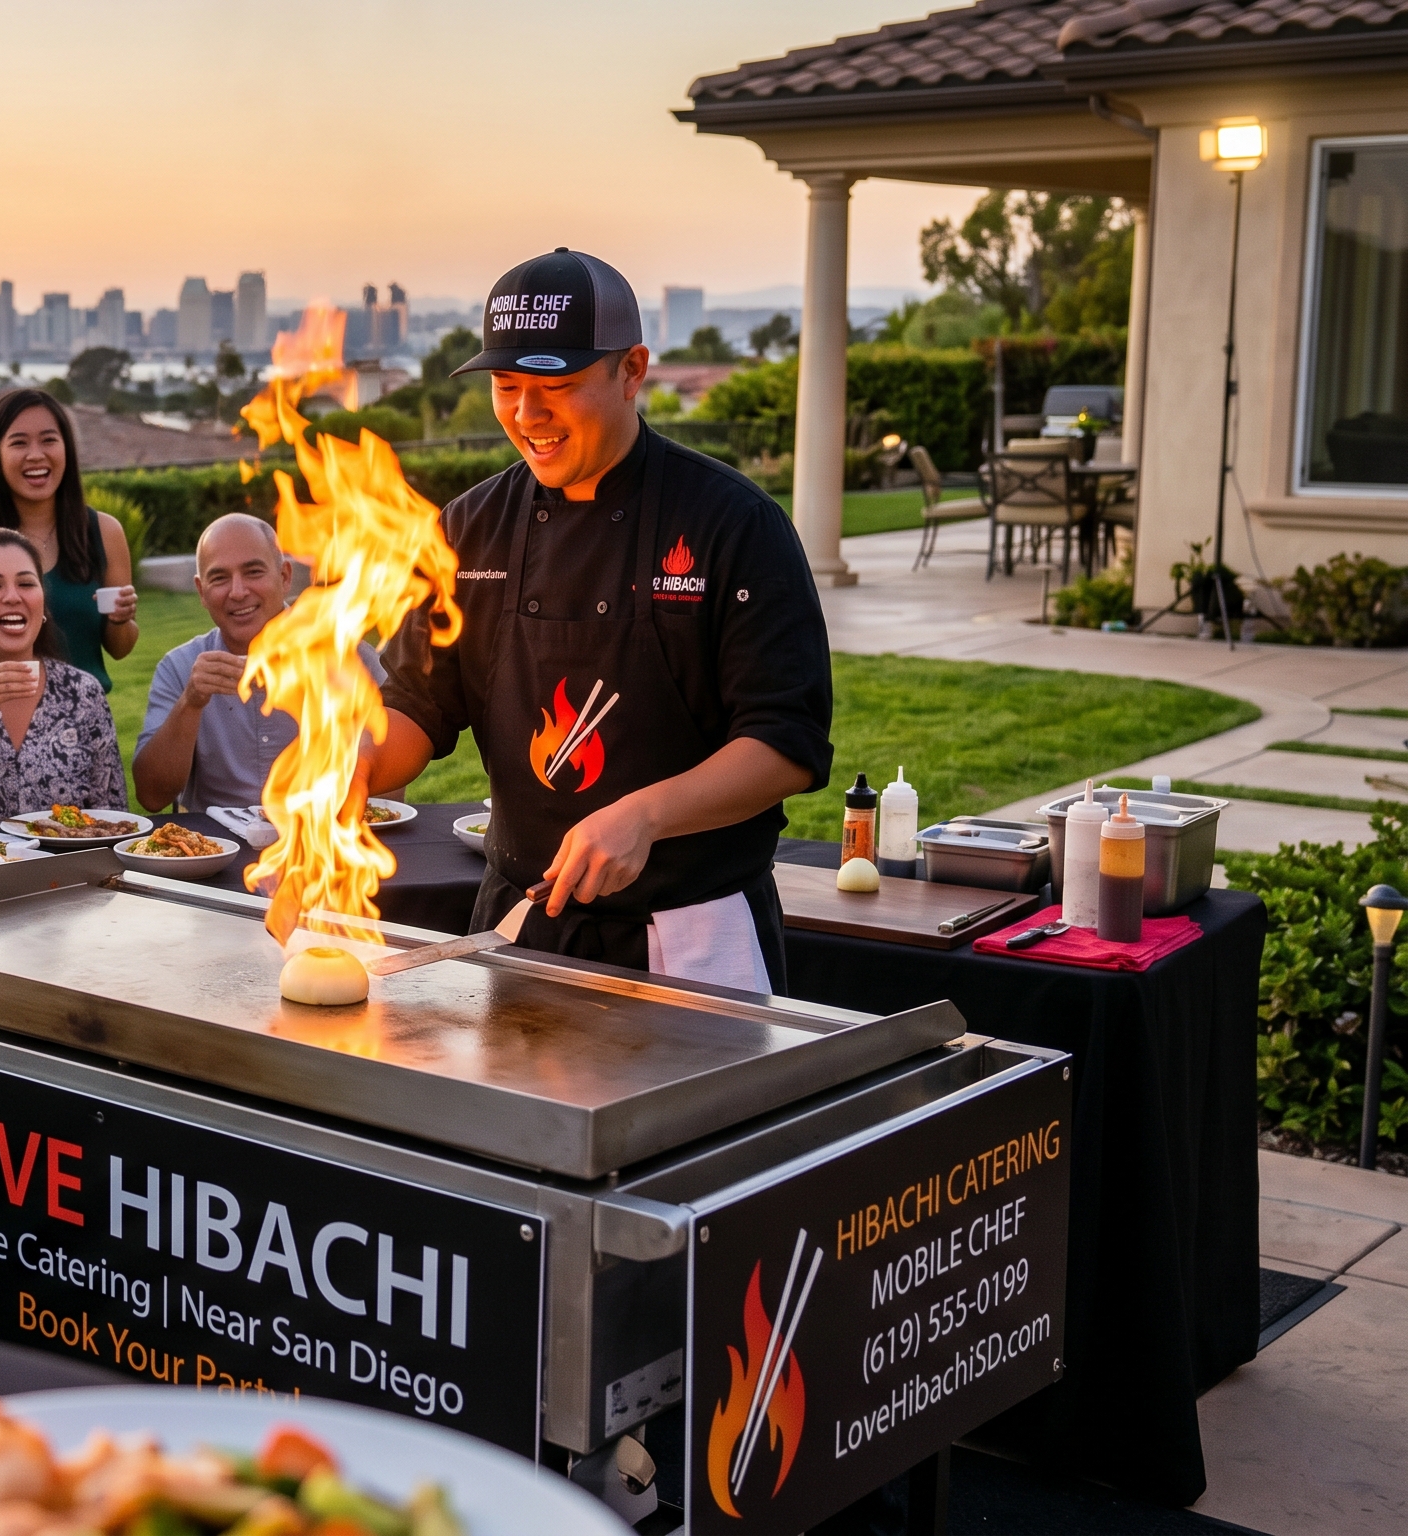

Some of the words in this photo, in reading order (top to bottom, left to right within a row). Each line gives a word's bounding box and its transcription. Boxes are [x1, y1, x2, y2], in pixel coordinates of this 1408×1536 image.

[489, 294, 530, 315] MOBILE
[533, 294, 573, 311] CHEF
[492, 313, 512, 332] SAN
[514, 313, 559, 330] DIEGO
[108, 1154, 469, 1350] HIBACHI
[836, 1174, 940, 1261] HIBACHI
[946, 1120, 1060, 1206] CATERING
[871, 1227, 963, 1310] MOBILE
[968, 1195, 1027, 1257] CHEF
[17, 1232, 152, 1318] Catering
[180, 1284, 262, 1347] Near
[271, 1316, 336, 1375] San
[349, 1340, 465, 1416] Diego
[18, 1291, 100, 1357] Book
[106, 1322, 186, 1386] Your
[196, 1353, 302, 1404] Part
[862, 1312, 921, 1385] (619)
[927, 1257, 1030, 1344] 555-0199
[834, 1313, 1051, 1460] LoveHibachiSD.com
